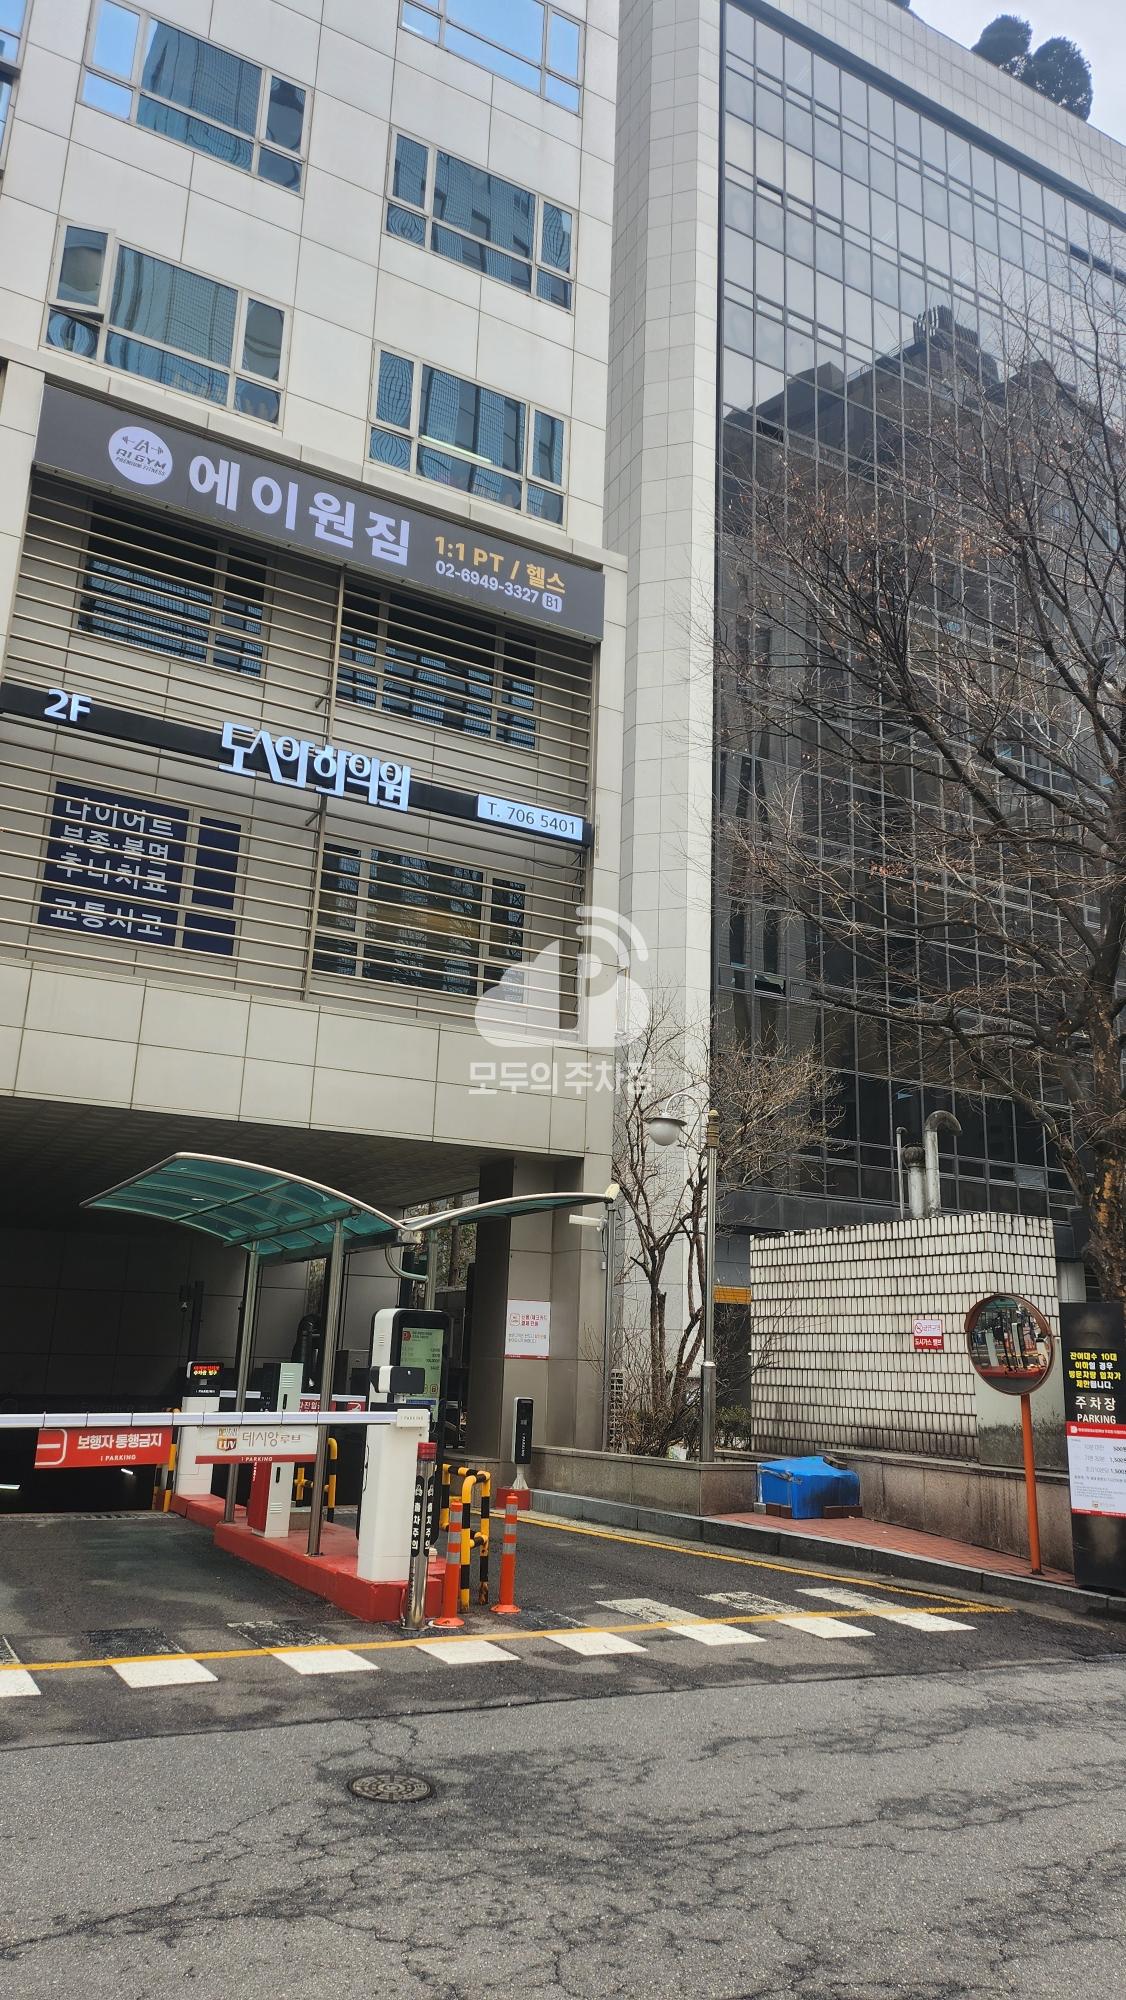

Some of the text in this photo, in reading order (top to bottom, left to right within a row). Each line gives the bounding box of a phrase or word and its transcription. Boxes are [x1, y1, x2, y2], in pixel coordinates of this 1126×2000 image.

[135, 454, 167, 470] GYM
[142, 465, 166, 477] FITNESS
[188, 455, 411, 567] 에이원짐
[434, 535, 466, 562] 1:1
[473, 547, 504, 573] PT
[526, 563, 566, 594] 헬스
[435, 560, 560, 610] 02-6949-3327 B1
[44, 688, 92, 722] 2F
[487, 801, 575, 835] T. 706 5401
[50, 897, 163, 937] 교통사고
[1101, 1353, 1118, 1361] 10대
[1099, 1362, 1113, 1370] 경우
[1075, 1395, 1116, 1411] 주차장
[1077, 1413, 1117, 1424] PARKING
[77, 1433, 162, 1450] 보행자 통행금지
